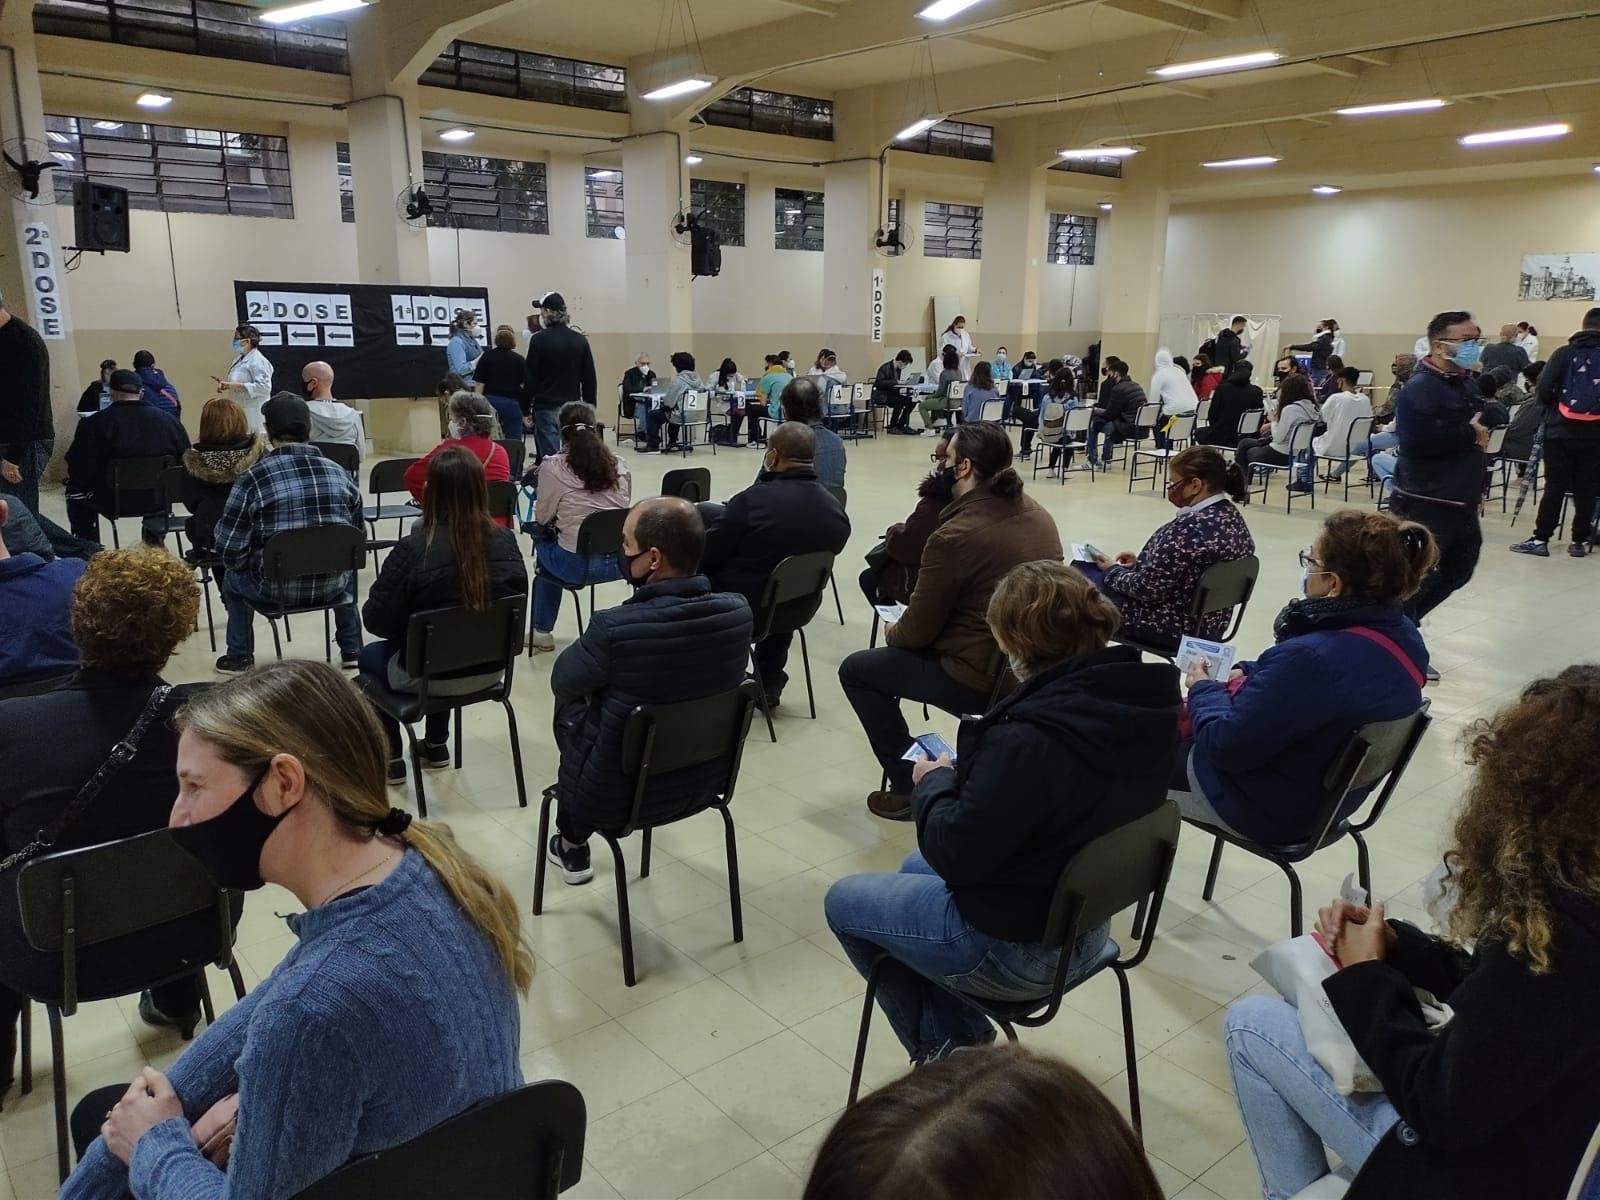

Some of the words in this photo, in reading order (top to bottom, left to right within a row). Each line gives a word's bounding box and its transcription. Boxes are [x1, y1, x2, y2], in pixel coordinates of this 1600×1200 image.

[32, 251, 60, 335] DOSE
[273, 303, 348, 319] DOSE
[874, 290, 882, 339] DOSE
[836, 389, 842, 400] 4
[856, 387, 863, 398] 5
[953, 385, 959, 395] 6
[689, 395, 696, 407] 2
